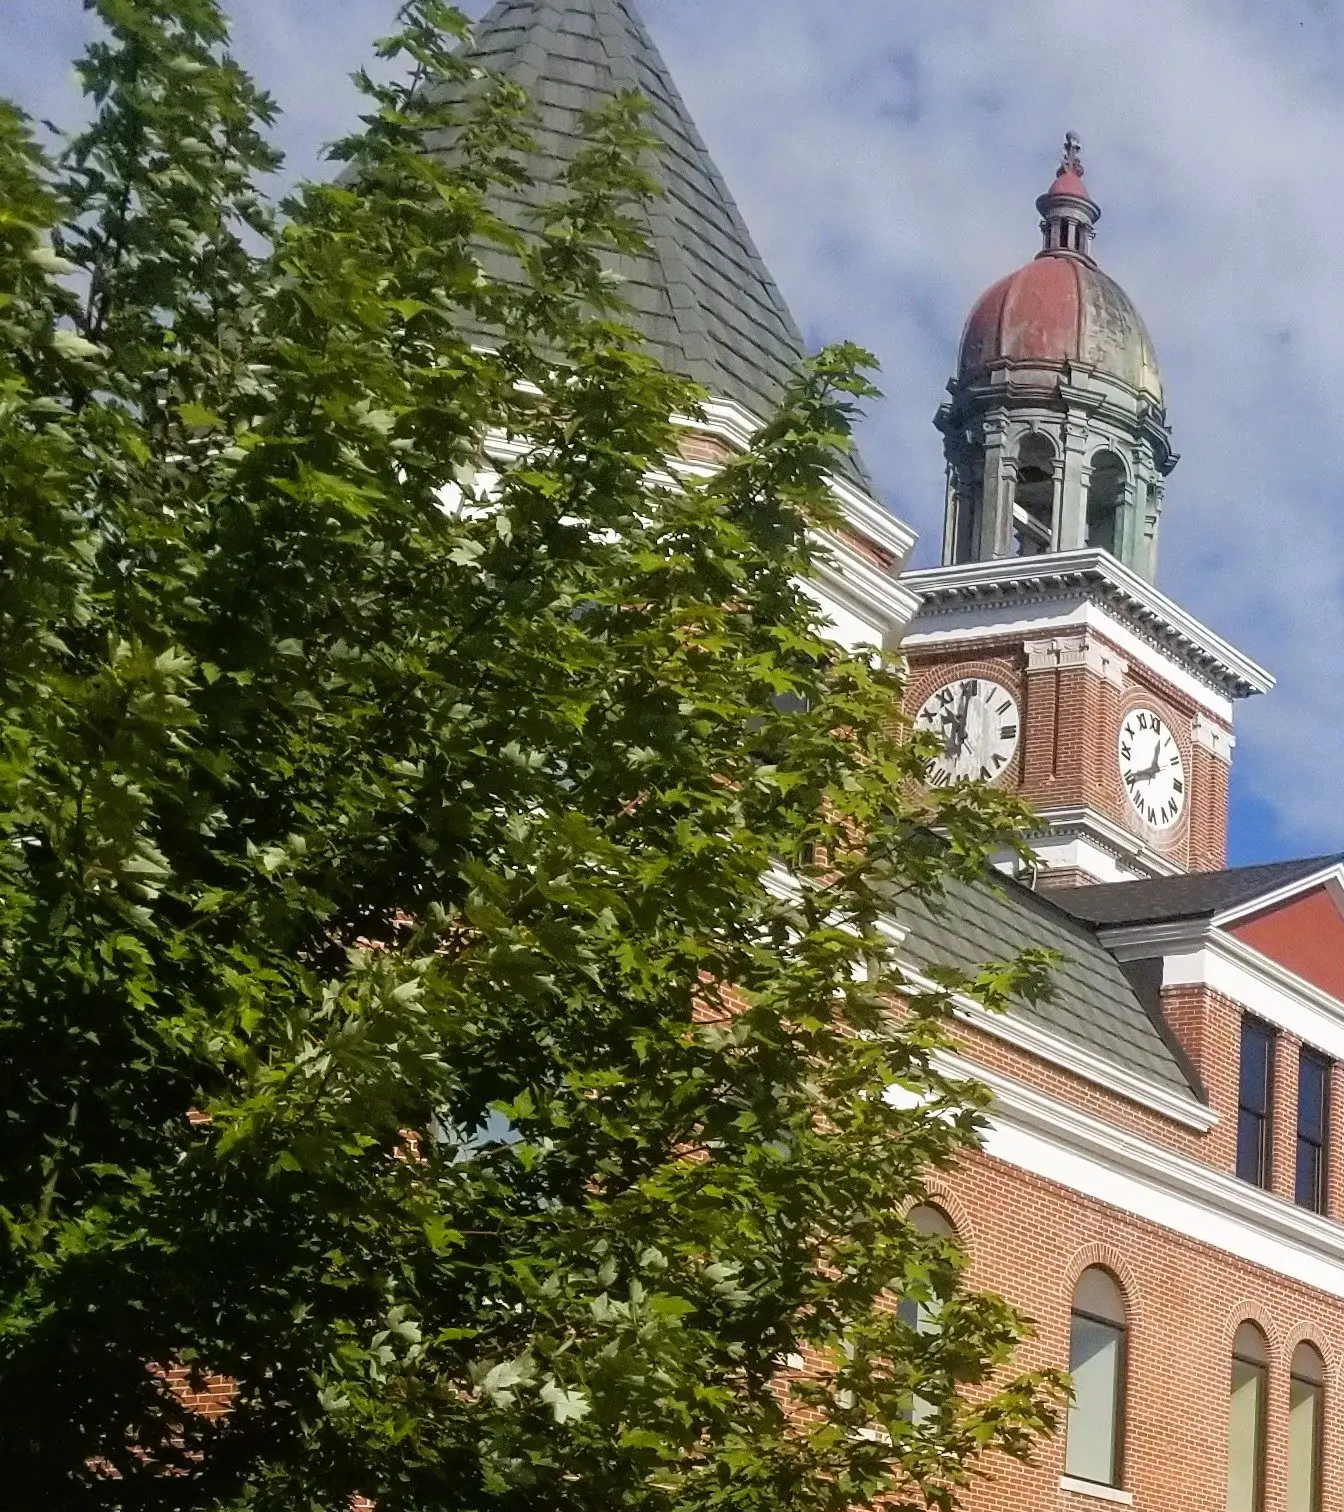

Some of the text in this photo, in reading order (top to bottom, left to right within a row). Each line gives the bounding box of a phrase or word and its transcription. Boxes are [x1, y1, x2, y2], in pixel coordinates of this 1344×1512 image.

[920, 707, 937, 723] X
[995, 700, 1012, 715] II
[1125, 722, 1135, 741] X
